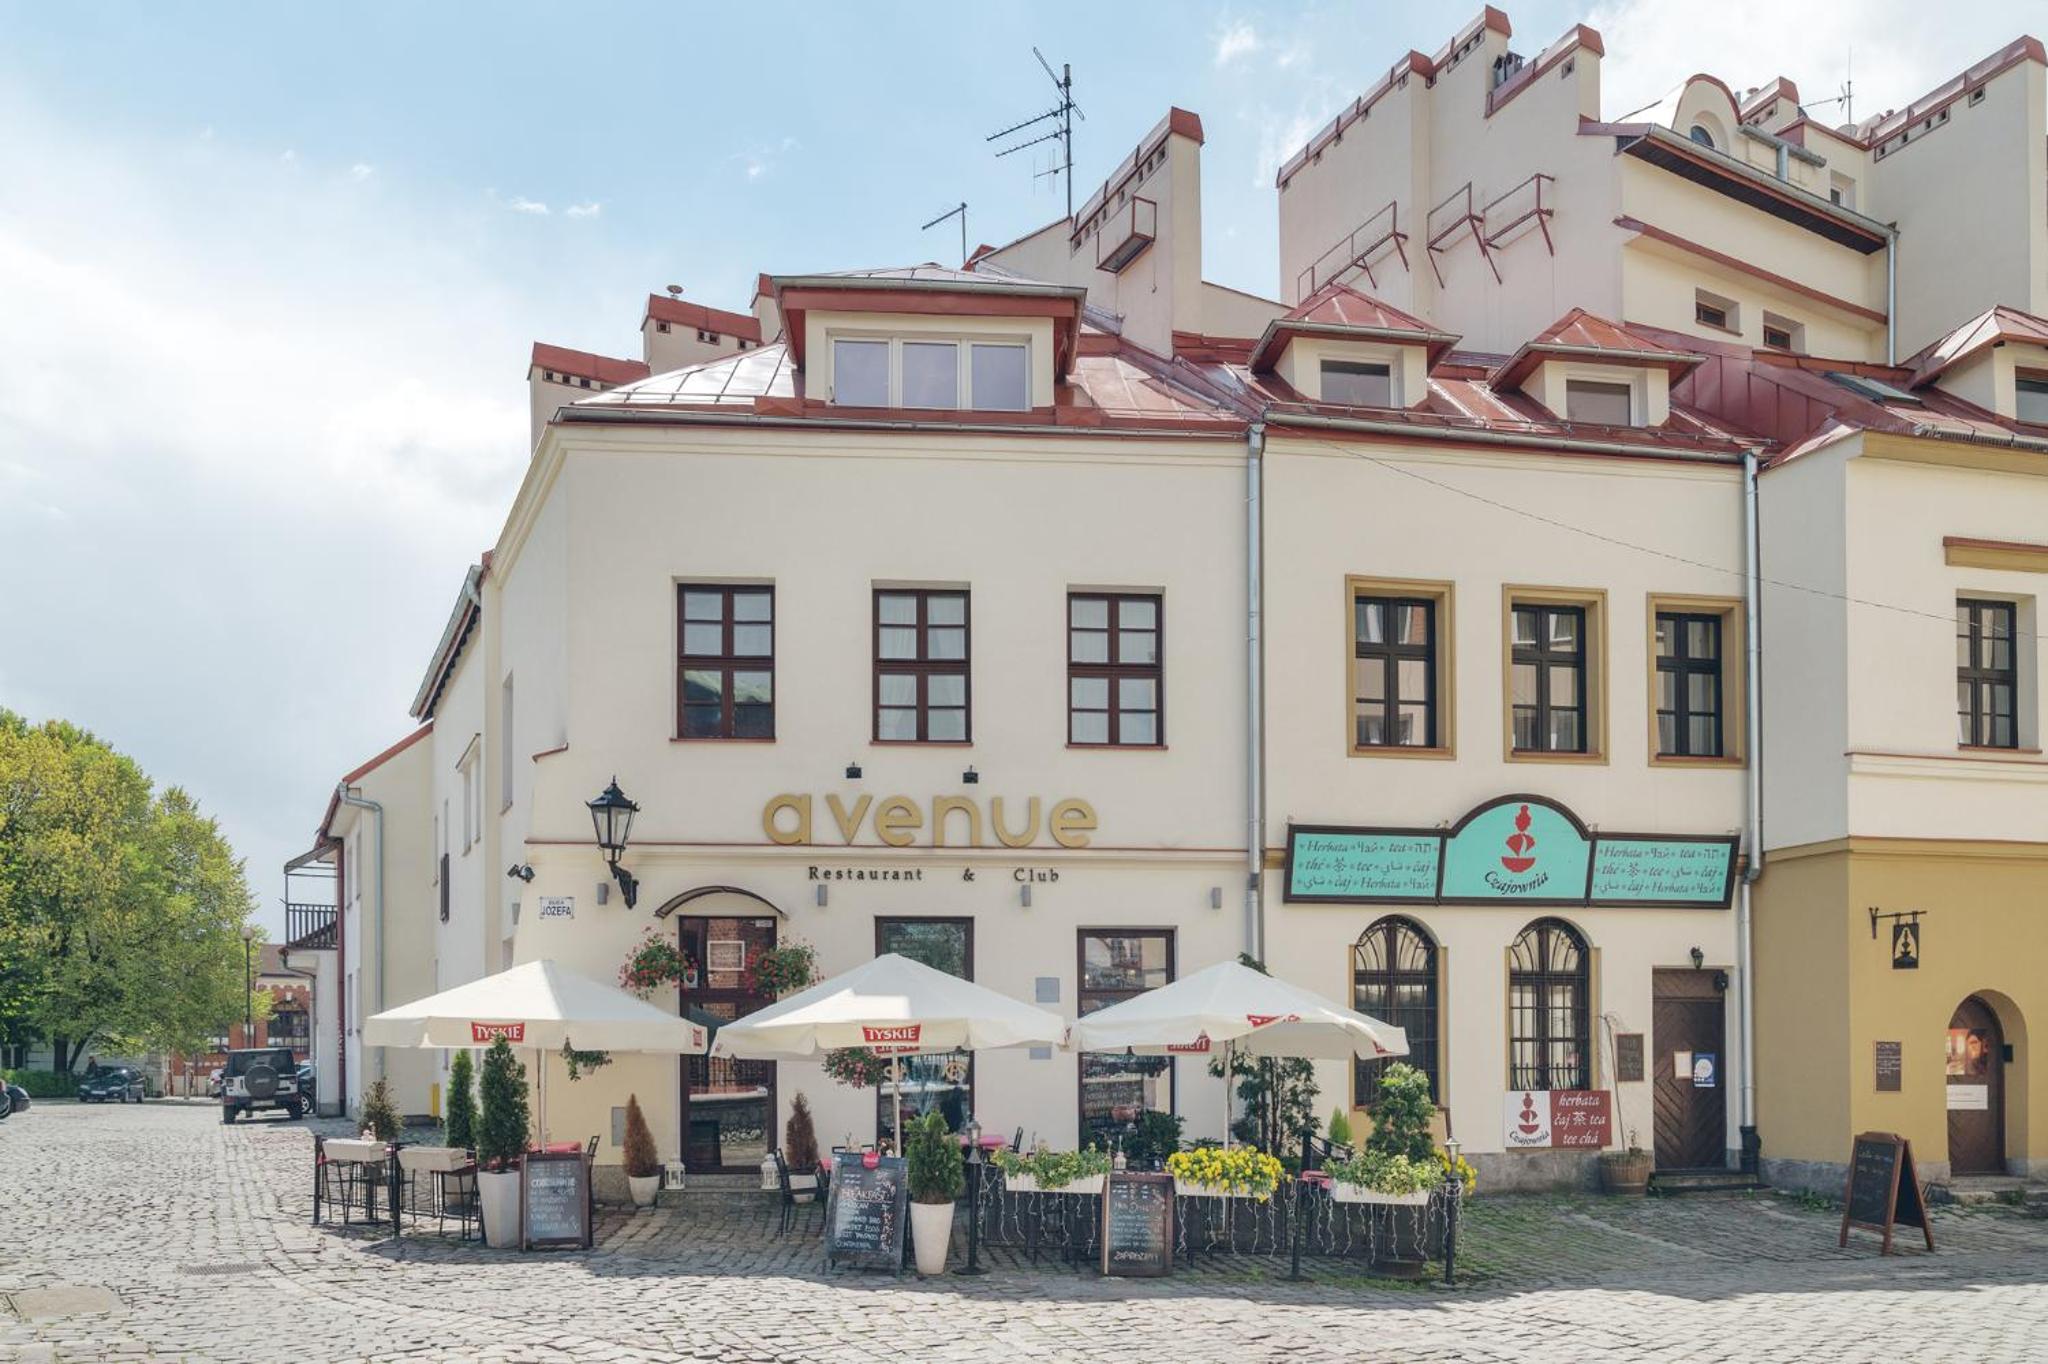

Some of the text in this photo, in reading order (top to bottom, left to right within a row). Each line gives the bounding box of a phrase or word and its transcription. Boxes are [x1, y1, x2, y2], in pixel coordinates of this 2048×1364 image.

[762, 793, 1098, 848] avenue
[808, 866, 1060, 882] Restaurant & Club
[476, 1024, 521, 1040] TYSKIE
[866, 1027, 916, 1040] TYSKIE
[1558, 1092, 1600, 1107] herbata
[1590, 1112, 1606, 1125] tea
